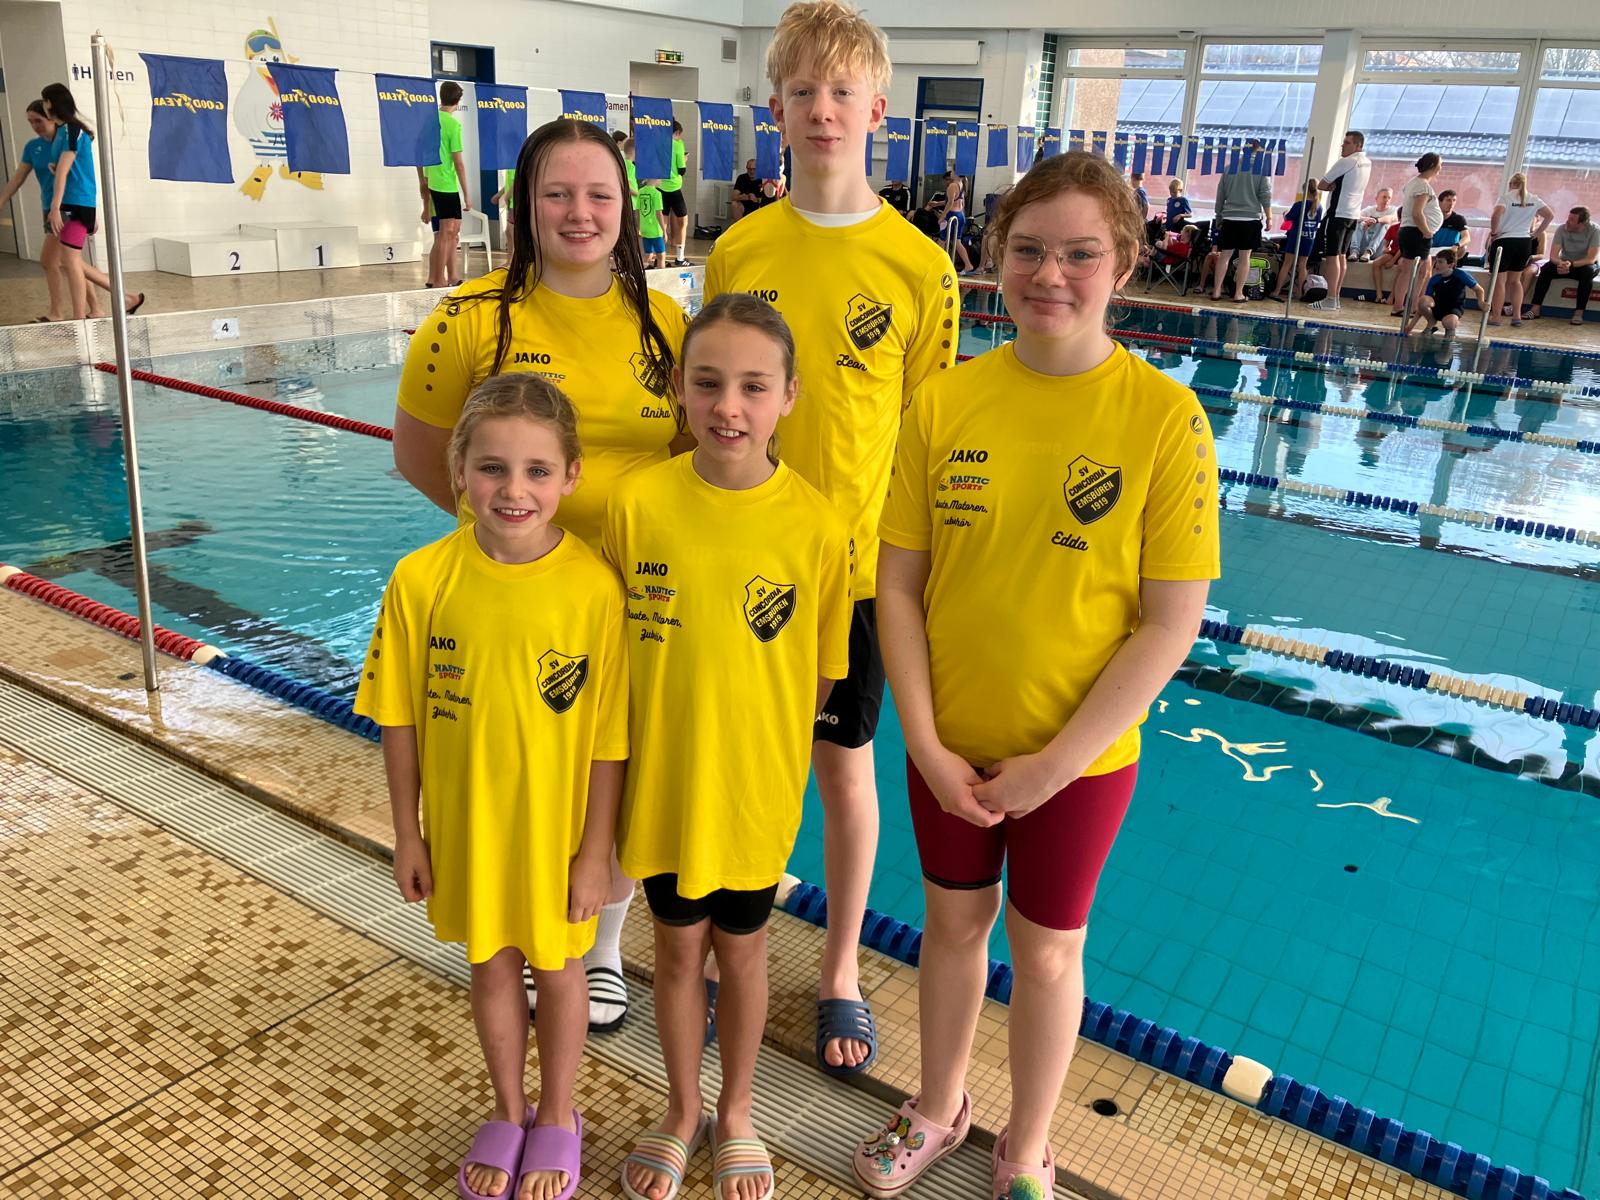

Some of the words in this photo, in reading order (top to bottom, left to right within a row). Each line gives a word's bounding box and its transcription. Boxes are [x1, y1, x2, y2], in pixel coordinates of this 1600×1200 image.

[80, 66, 135, 82] Hren
[230, 251, 241, 271] 2
[315, 245, 324, 267] 1
[386, 246, 394, 261] 3
[849, 304, 881, 327] CONCORDIA
[221, 322, 229, 333] 4
[514, 352, 551, 365] JAKO
[835, 353, 868, 372] Leon
[640, 406, 671, 419] Anika
[948, 449, 989, 464] JAKO
[1078, 465, 1089, 477] SV
[949, 475, 991, 485] NAUTIC
[951, 483, 983, 492] SPORTS
[1068, 467, 1107, 497] CONCORDIA
[1090, 496, 1109, 512] 1919
[1050, 530, 1089, 552] Edda
[635, 561, 668, 577] JAKO
[644, 585, 677, 596] NAUTIC
[756, 585, 767, 598] SV
[748, 587, 783, 618] CONCORDIA
[769, 613, 783, 630] 1919
[430, 635, 457, 651] AKO
[548, 658, 560, 670] SV
[541, 660, 577, 689] CONCORDIA
[815, 711, 839, 725] AKO
